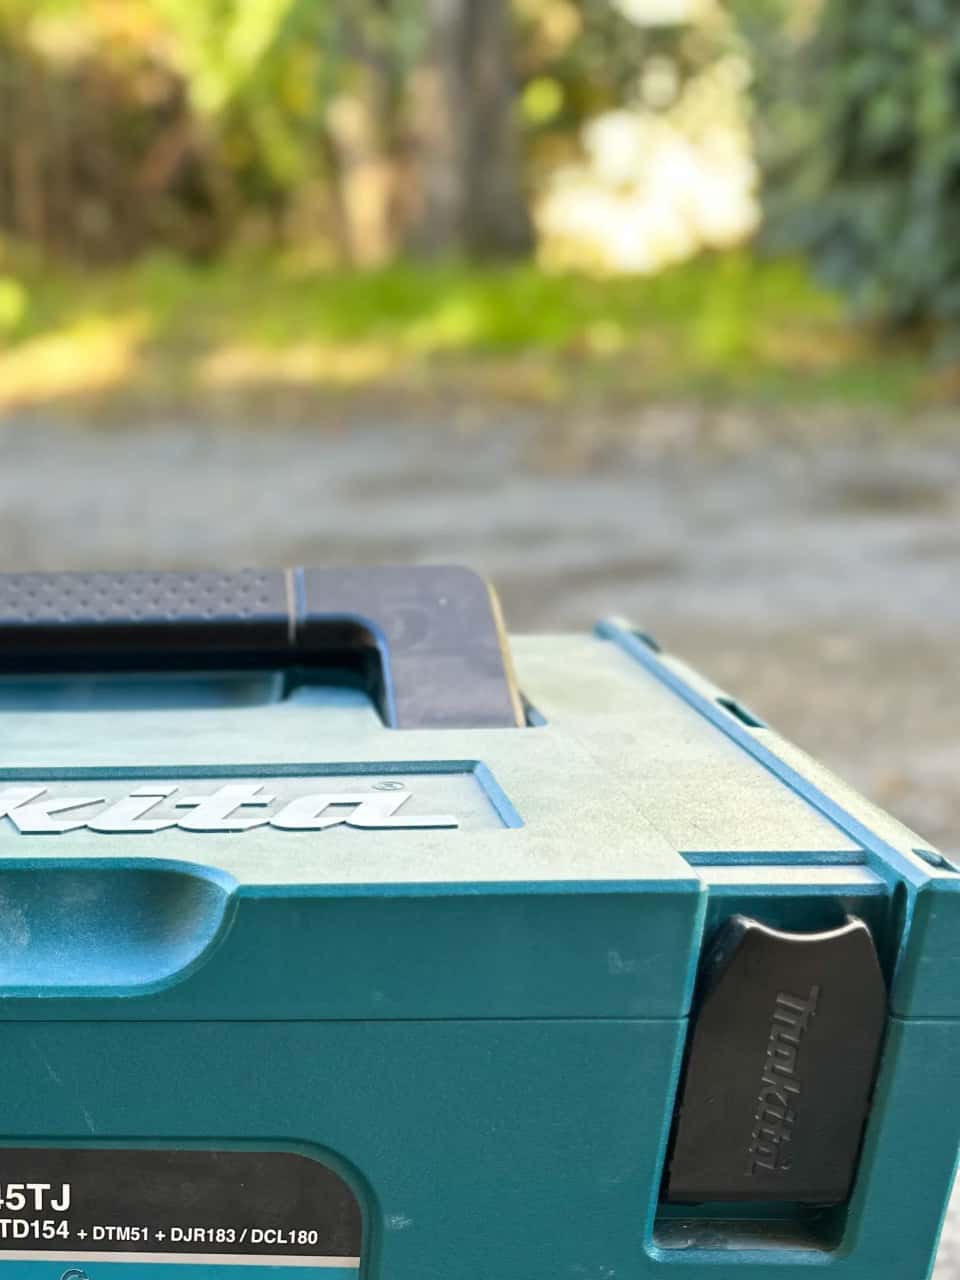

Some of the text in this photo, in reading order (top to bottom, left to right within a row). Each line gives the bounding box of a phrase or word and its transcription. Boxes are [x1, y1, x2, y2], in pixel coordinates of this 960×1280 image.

[92, 1226, 149, 1242] DTM51
[170, 1227, 236, 1243] DJR183
[251, 1229, 318, 1245] DCL180
